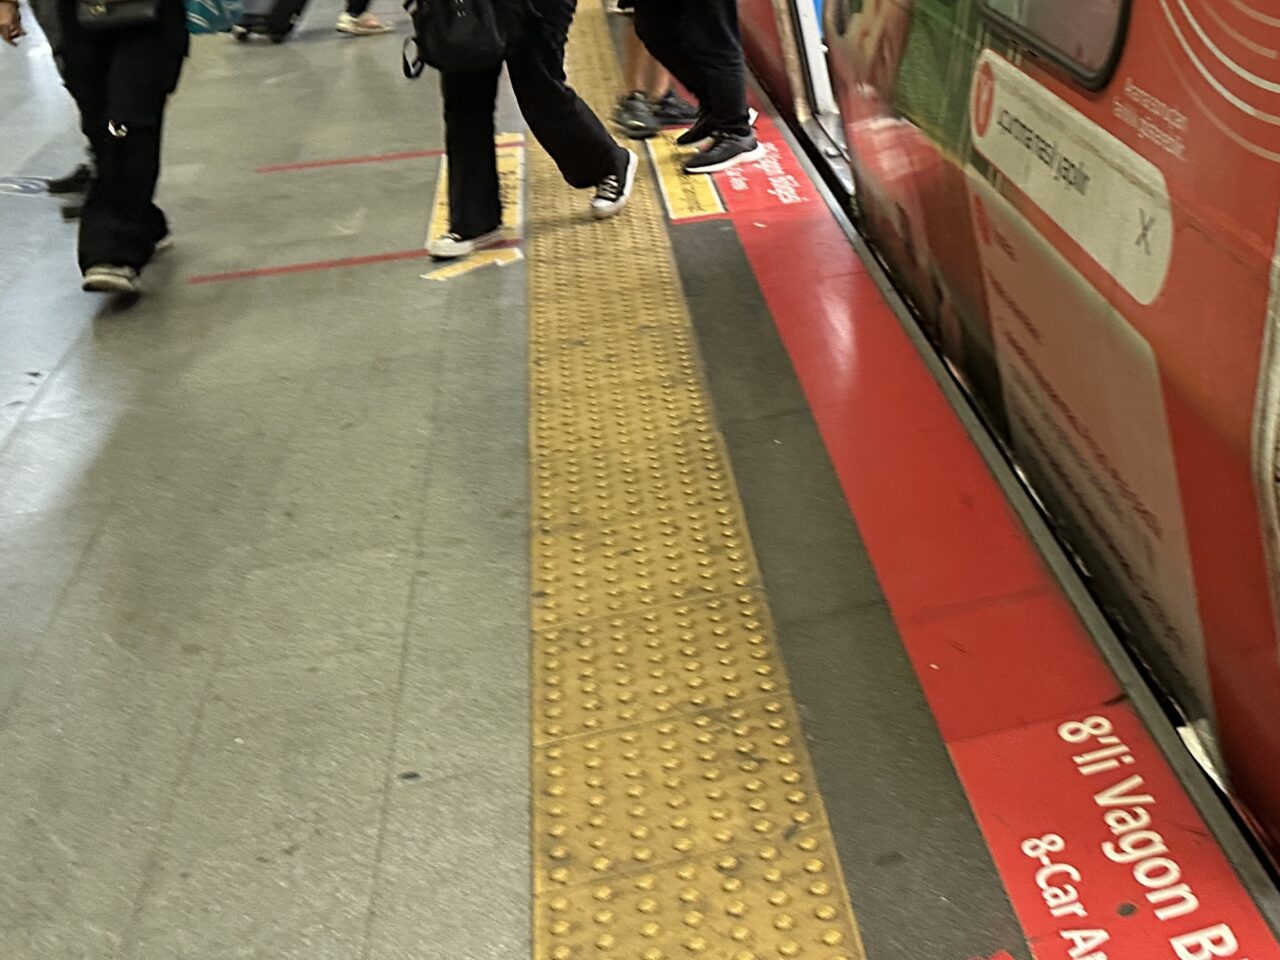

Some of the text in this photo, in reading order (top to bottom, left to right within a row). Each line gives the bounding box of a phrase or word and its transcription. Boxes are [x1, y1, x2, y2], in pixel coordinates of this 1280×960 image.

[1020, 833, 1111, 960] 8-Car A
[1057, 715, 1251, 960] 8'li Vagon B
